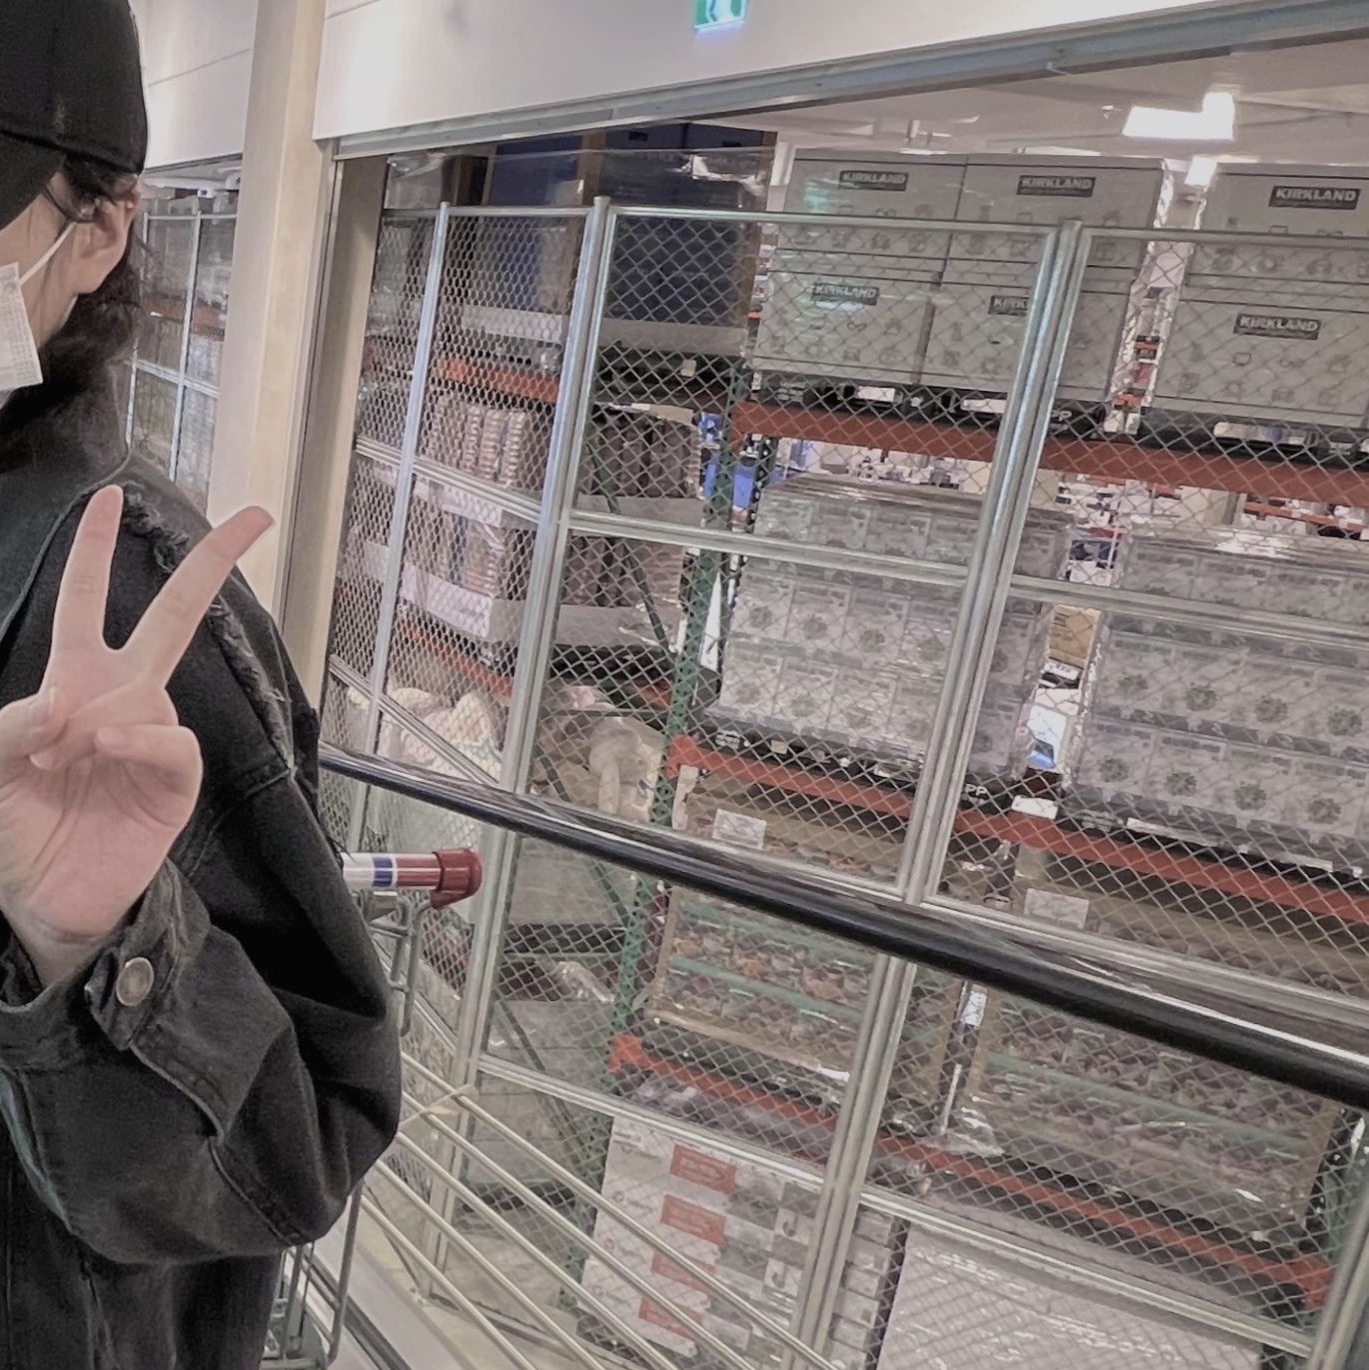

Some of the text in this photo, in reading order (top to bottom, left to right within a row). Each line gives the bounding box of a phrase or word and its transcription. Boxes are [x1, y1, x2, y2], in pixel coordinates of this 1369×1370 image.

[841, 172, 907, 185] KIRKLAND
[1022, 177, 1093, 190] KIRKLAND
[1275, 188, 1357, 202] KIRKLAND
[1239, 315, 1319, 332] KIRKLAND
